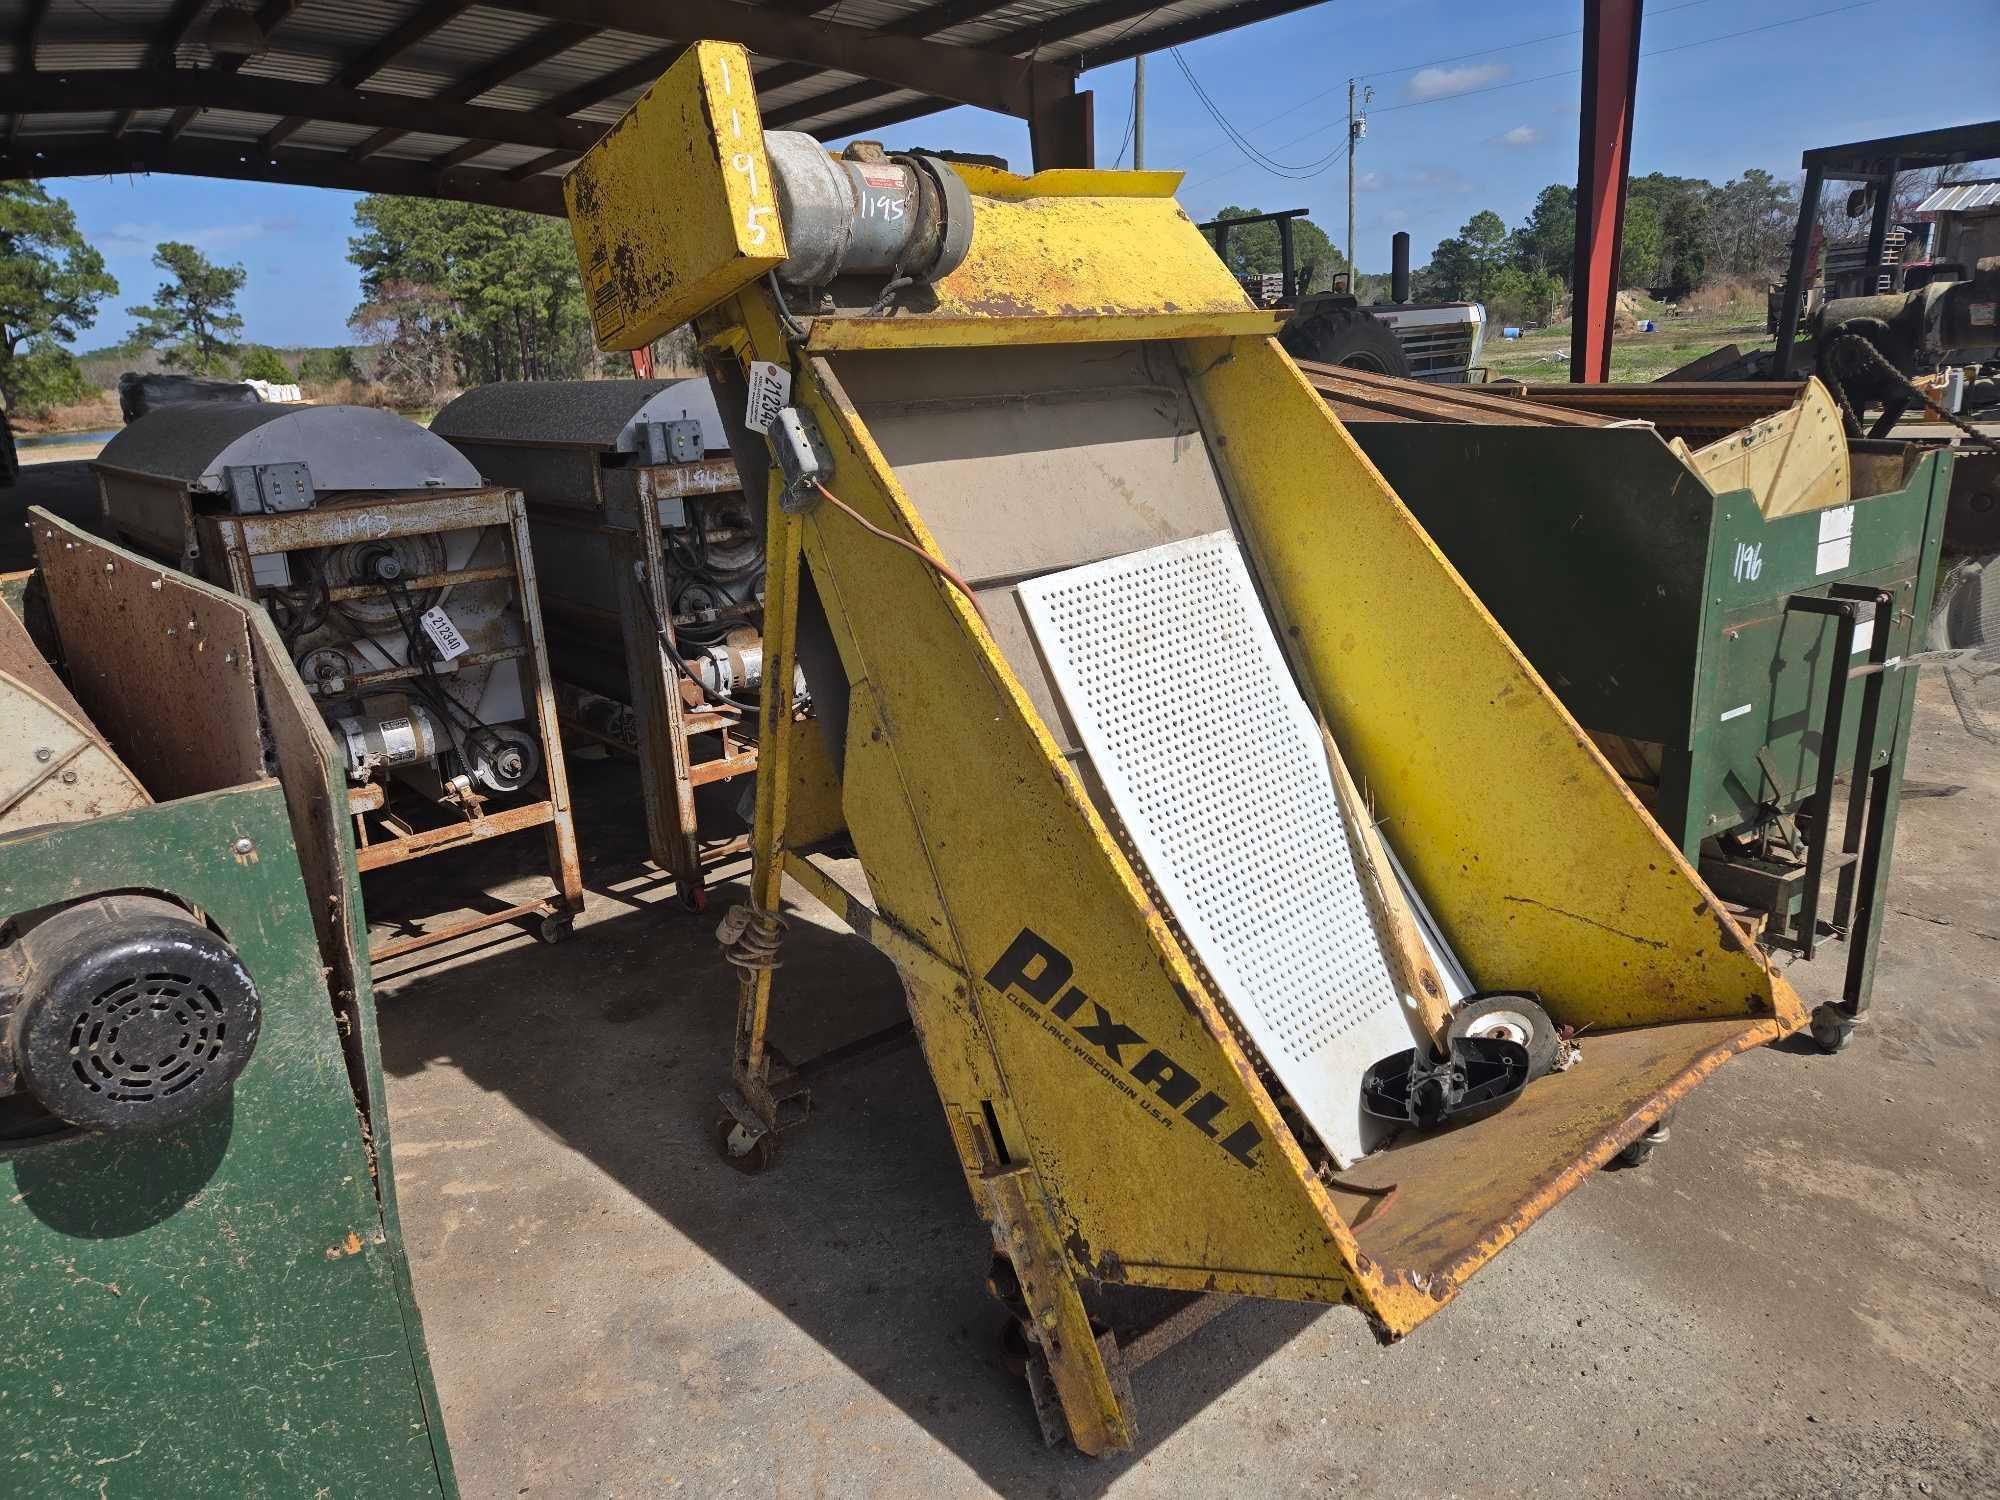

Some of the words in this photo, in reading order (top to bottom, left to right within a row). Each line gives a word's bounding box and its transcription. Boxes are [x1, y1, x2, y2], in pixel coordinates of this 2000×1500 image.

[719, 57, 775, 246] 1195
[861, 190, 906, 220] 1195
[338, 513, 391, 541] 1193
[1733, 541, 1762, 583] 1196
[432, 616, 461, 650] 212340
[1006, 992, 1041, 1022] CLEAR
[1042, 1020, 1072, 1050] LAKE,
[1074, 1045, 1138, 1100] WISCONSIN
[1140, 1099, 1174, 1131] U.S.A.
